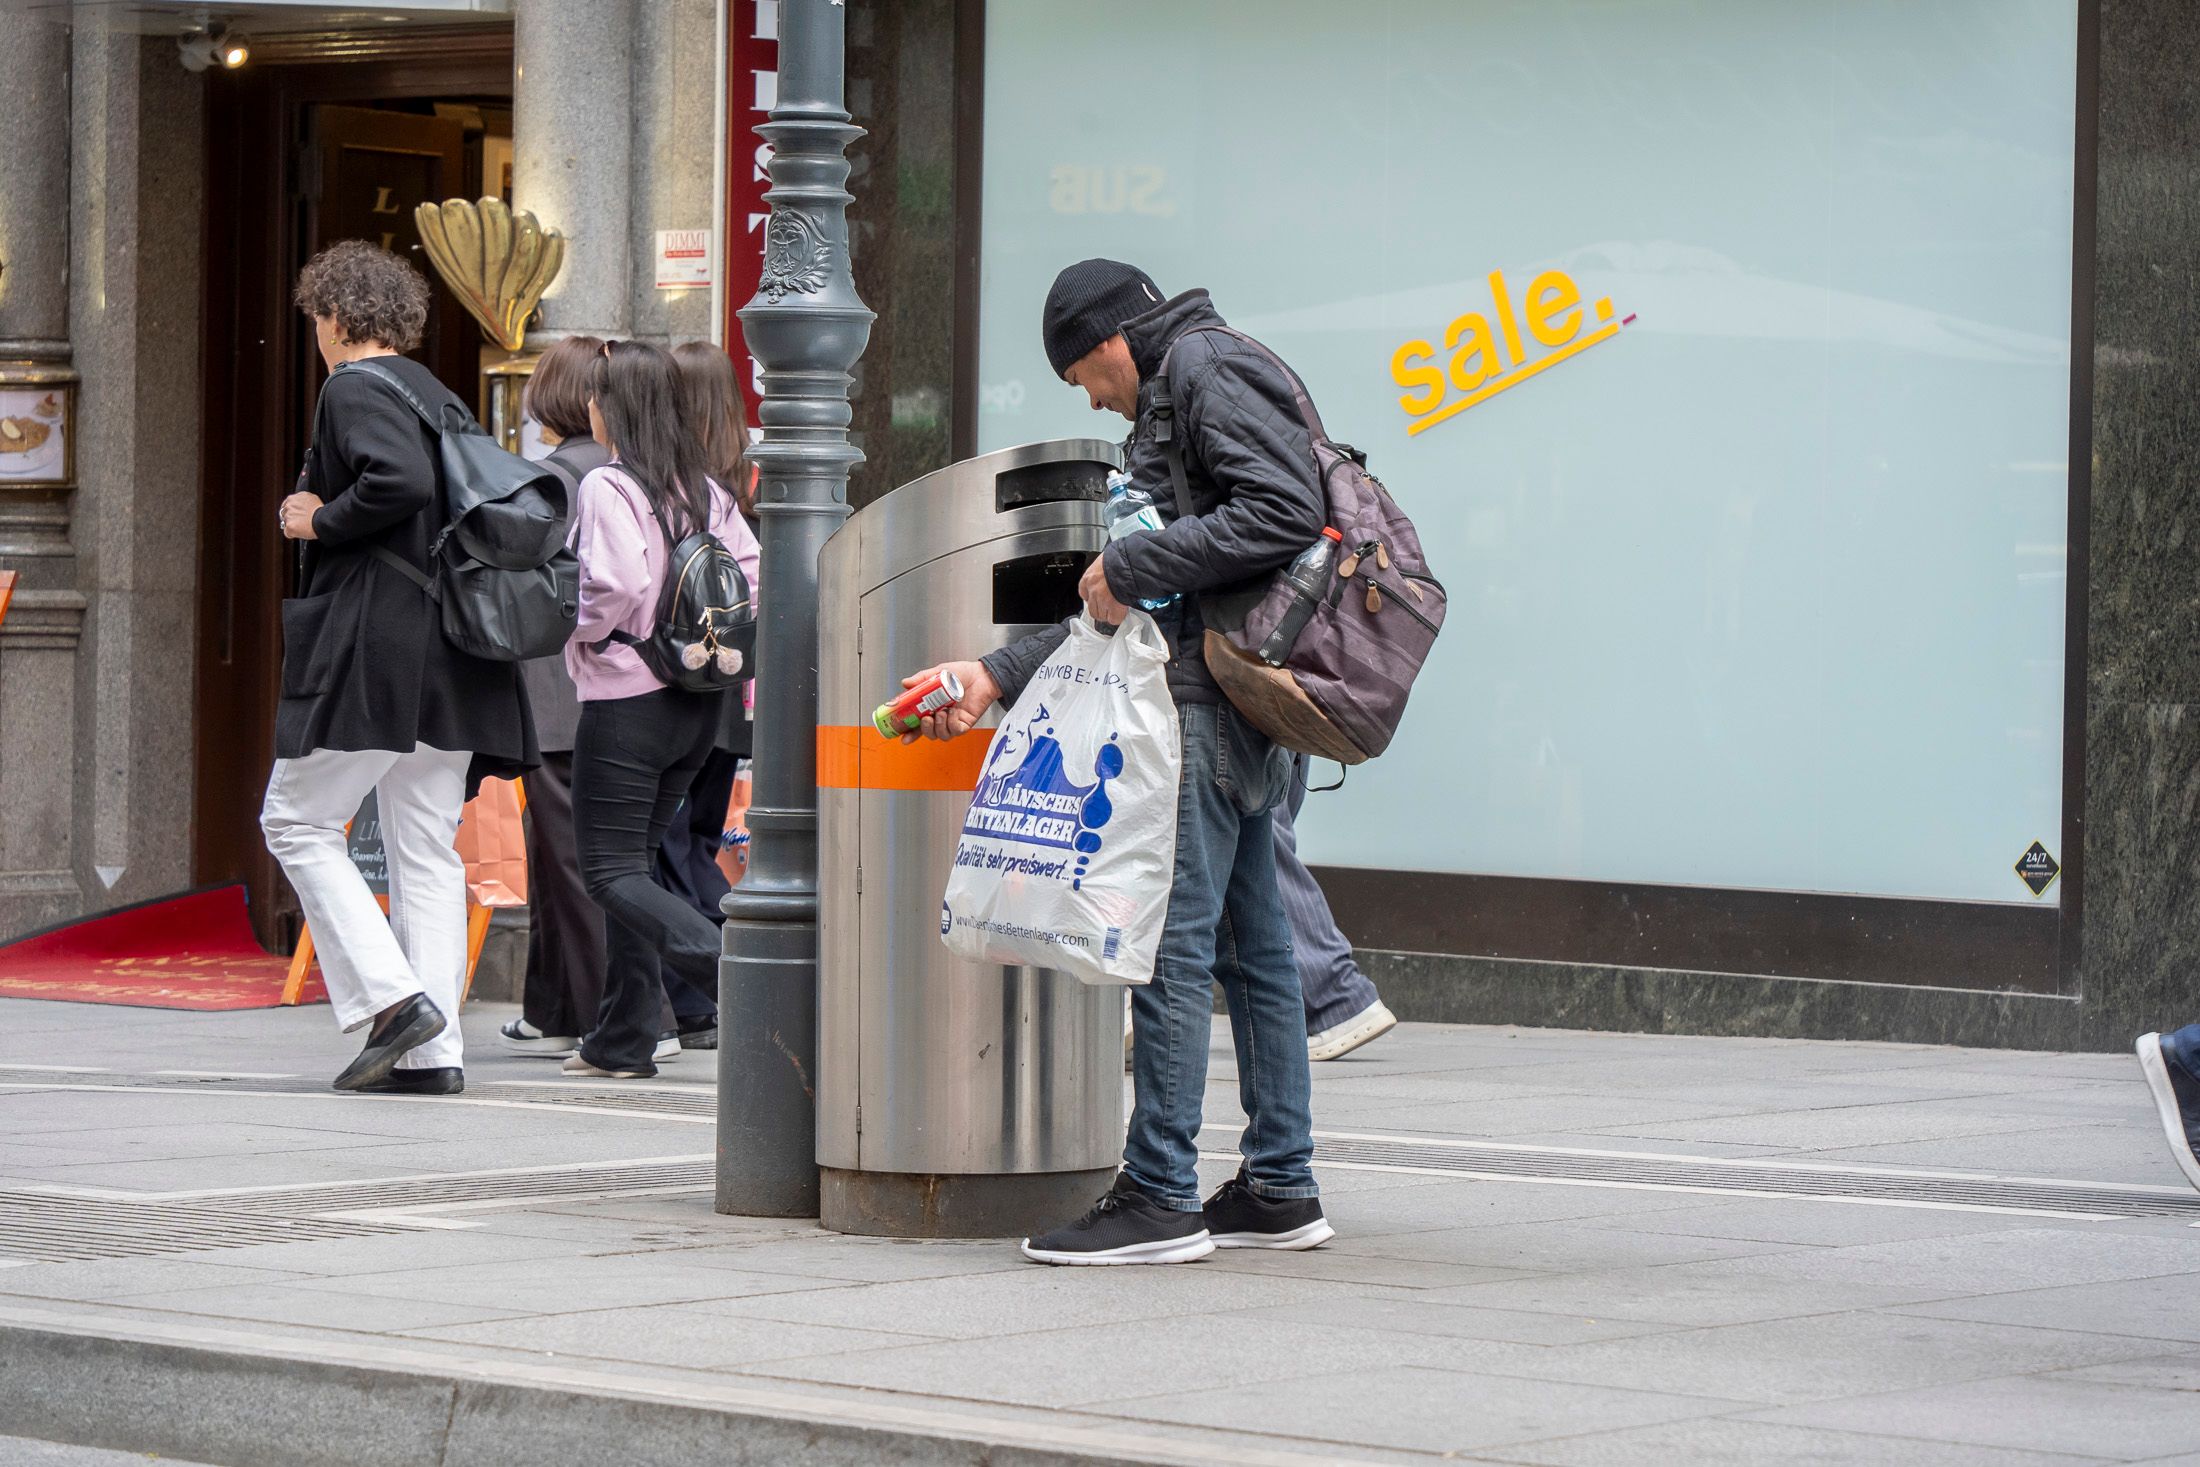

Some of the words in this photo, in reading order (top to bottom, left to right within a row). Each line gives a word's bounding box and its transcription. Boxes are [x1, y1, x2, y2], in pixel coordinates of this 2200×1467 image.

[665, 232, 705, 249] DIMMI
[1390, 268, 1616, 416] sale.
[987, 848, 1008, 870] sehr
[2025, 852, 2047, 865] 24/7
